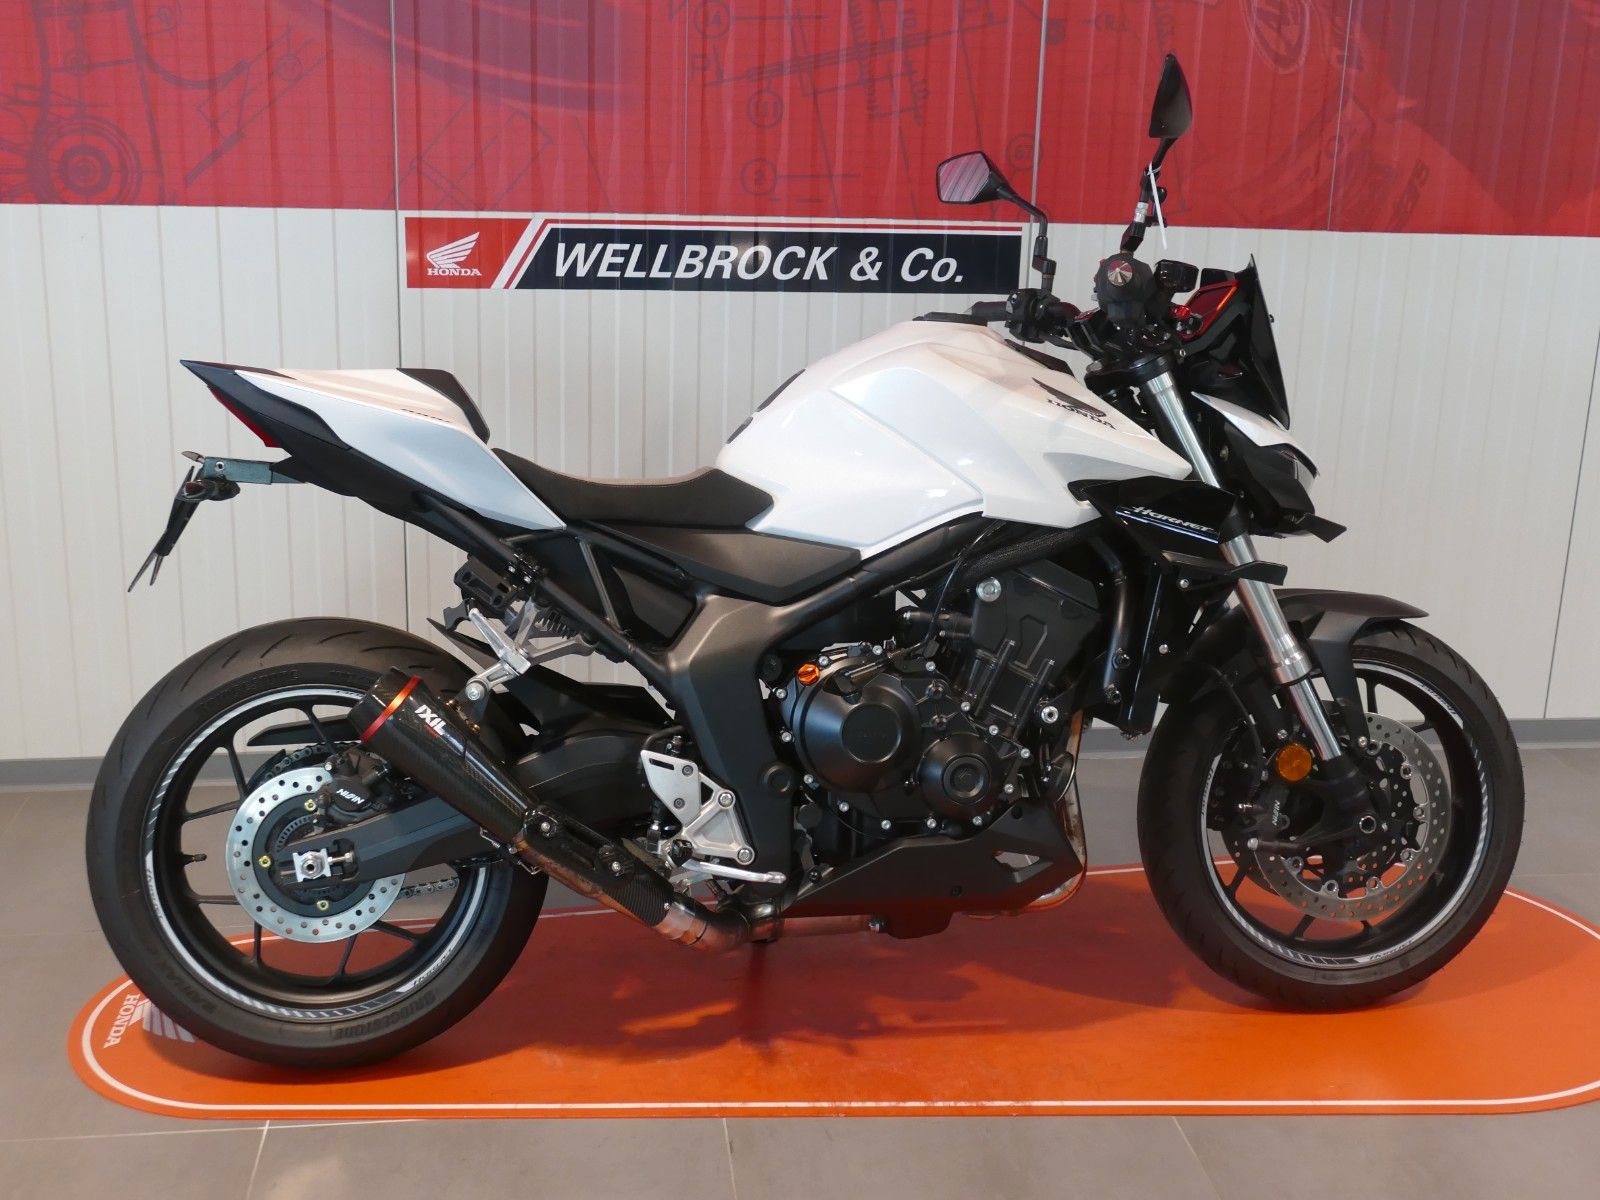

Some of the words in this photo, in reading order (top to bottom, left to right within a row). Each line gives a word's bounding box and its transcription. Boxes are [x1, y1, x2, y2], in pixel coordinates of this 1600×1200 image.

[426, 267, 482, 277] HONDA
[555, 242, 839, 281] WELLBROCK
[849, 246, 882, 281] &
[901, 247, 964, 283] Co.
[1047, 398, 1117, 431] HONDA
[414, 704, 447, 736] IXIL
[103, 993, 141, 1049] HONDA
